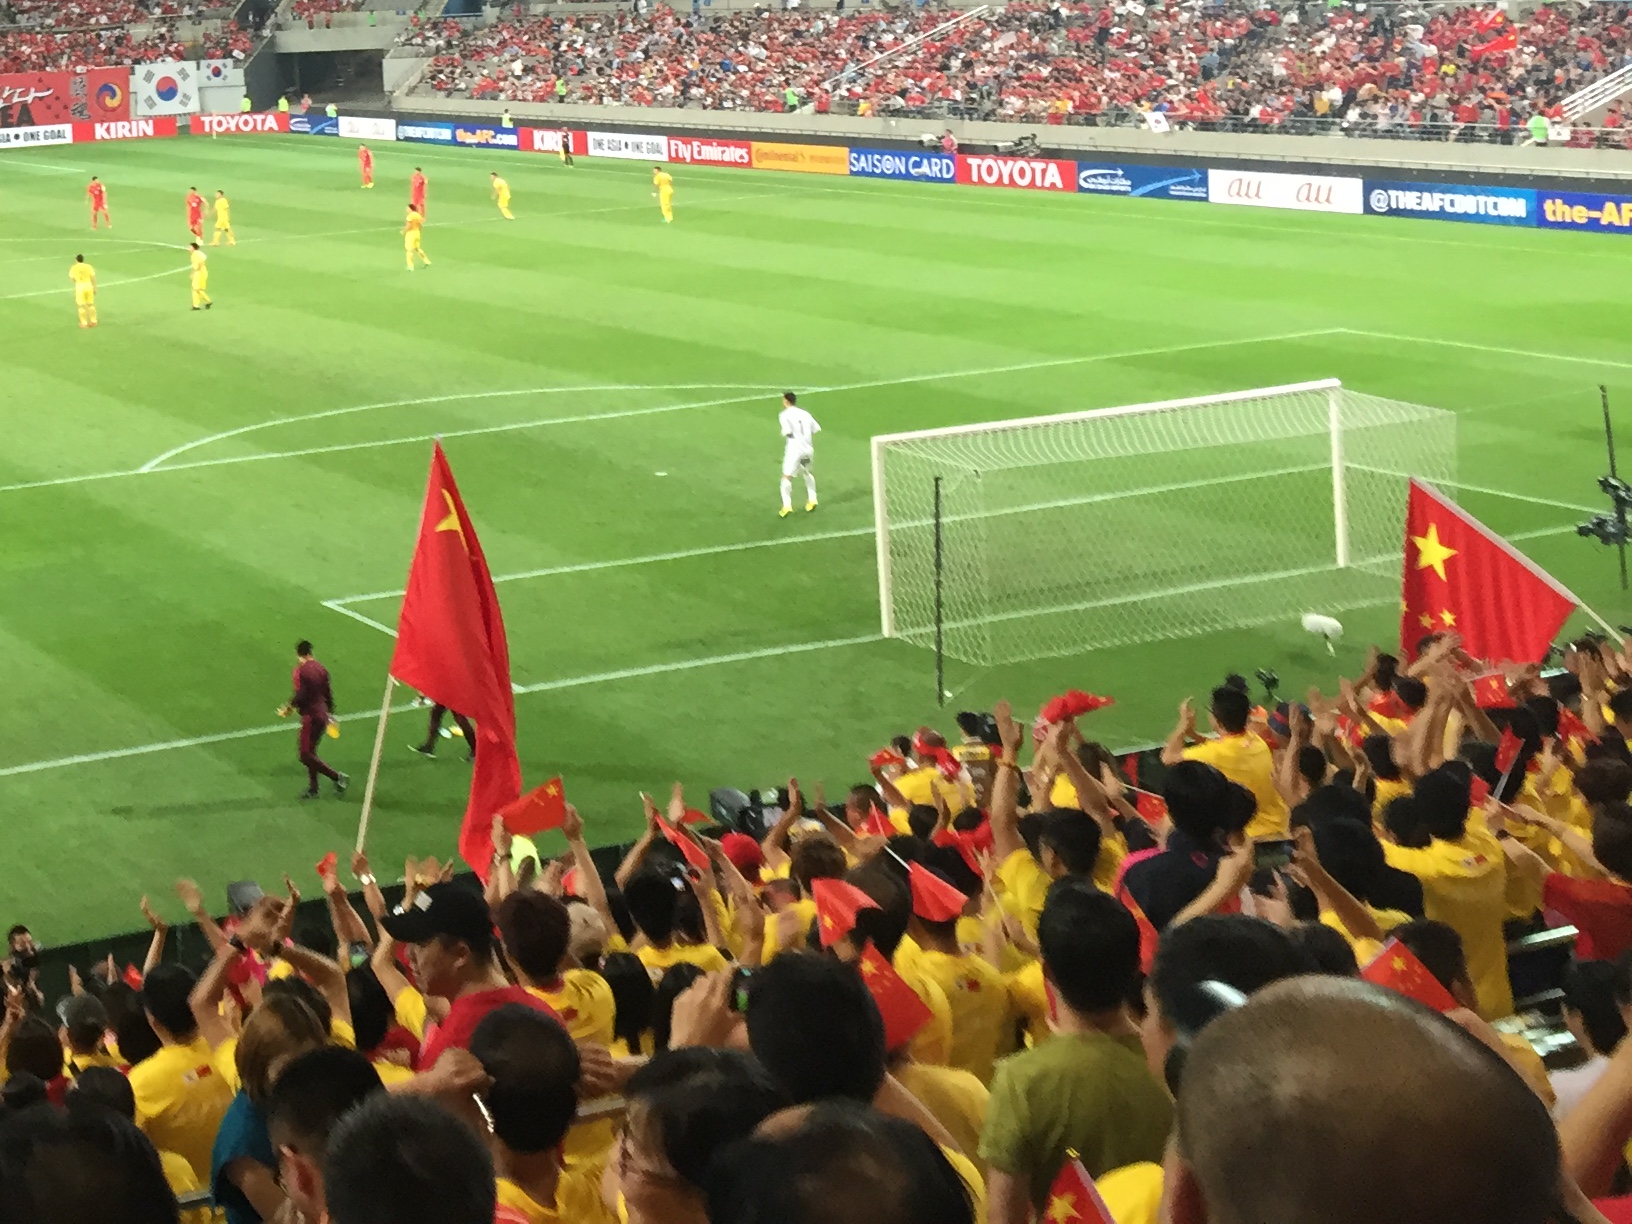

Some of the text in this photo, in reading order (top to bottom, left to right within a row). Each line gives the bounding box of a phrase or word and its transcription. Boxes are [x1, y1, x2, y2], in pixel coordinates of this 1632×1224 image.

[23, 131, 41, 142] ONE
[43, 129, 67, 140] GOAL
[94, 119, 154, 140] KIRIN
[201, 114, 279, 132] TOYOTA
[670, 139, 749, 164] Fly Emirates
[850, 153, 906, 175] SAISON
[908, 156, 955, 179] CARD
[967, 157, 1064, 189] TOYOTA
[1227, 177, 1263, 199] au
[1296, 180, 1334, 205] au
